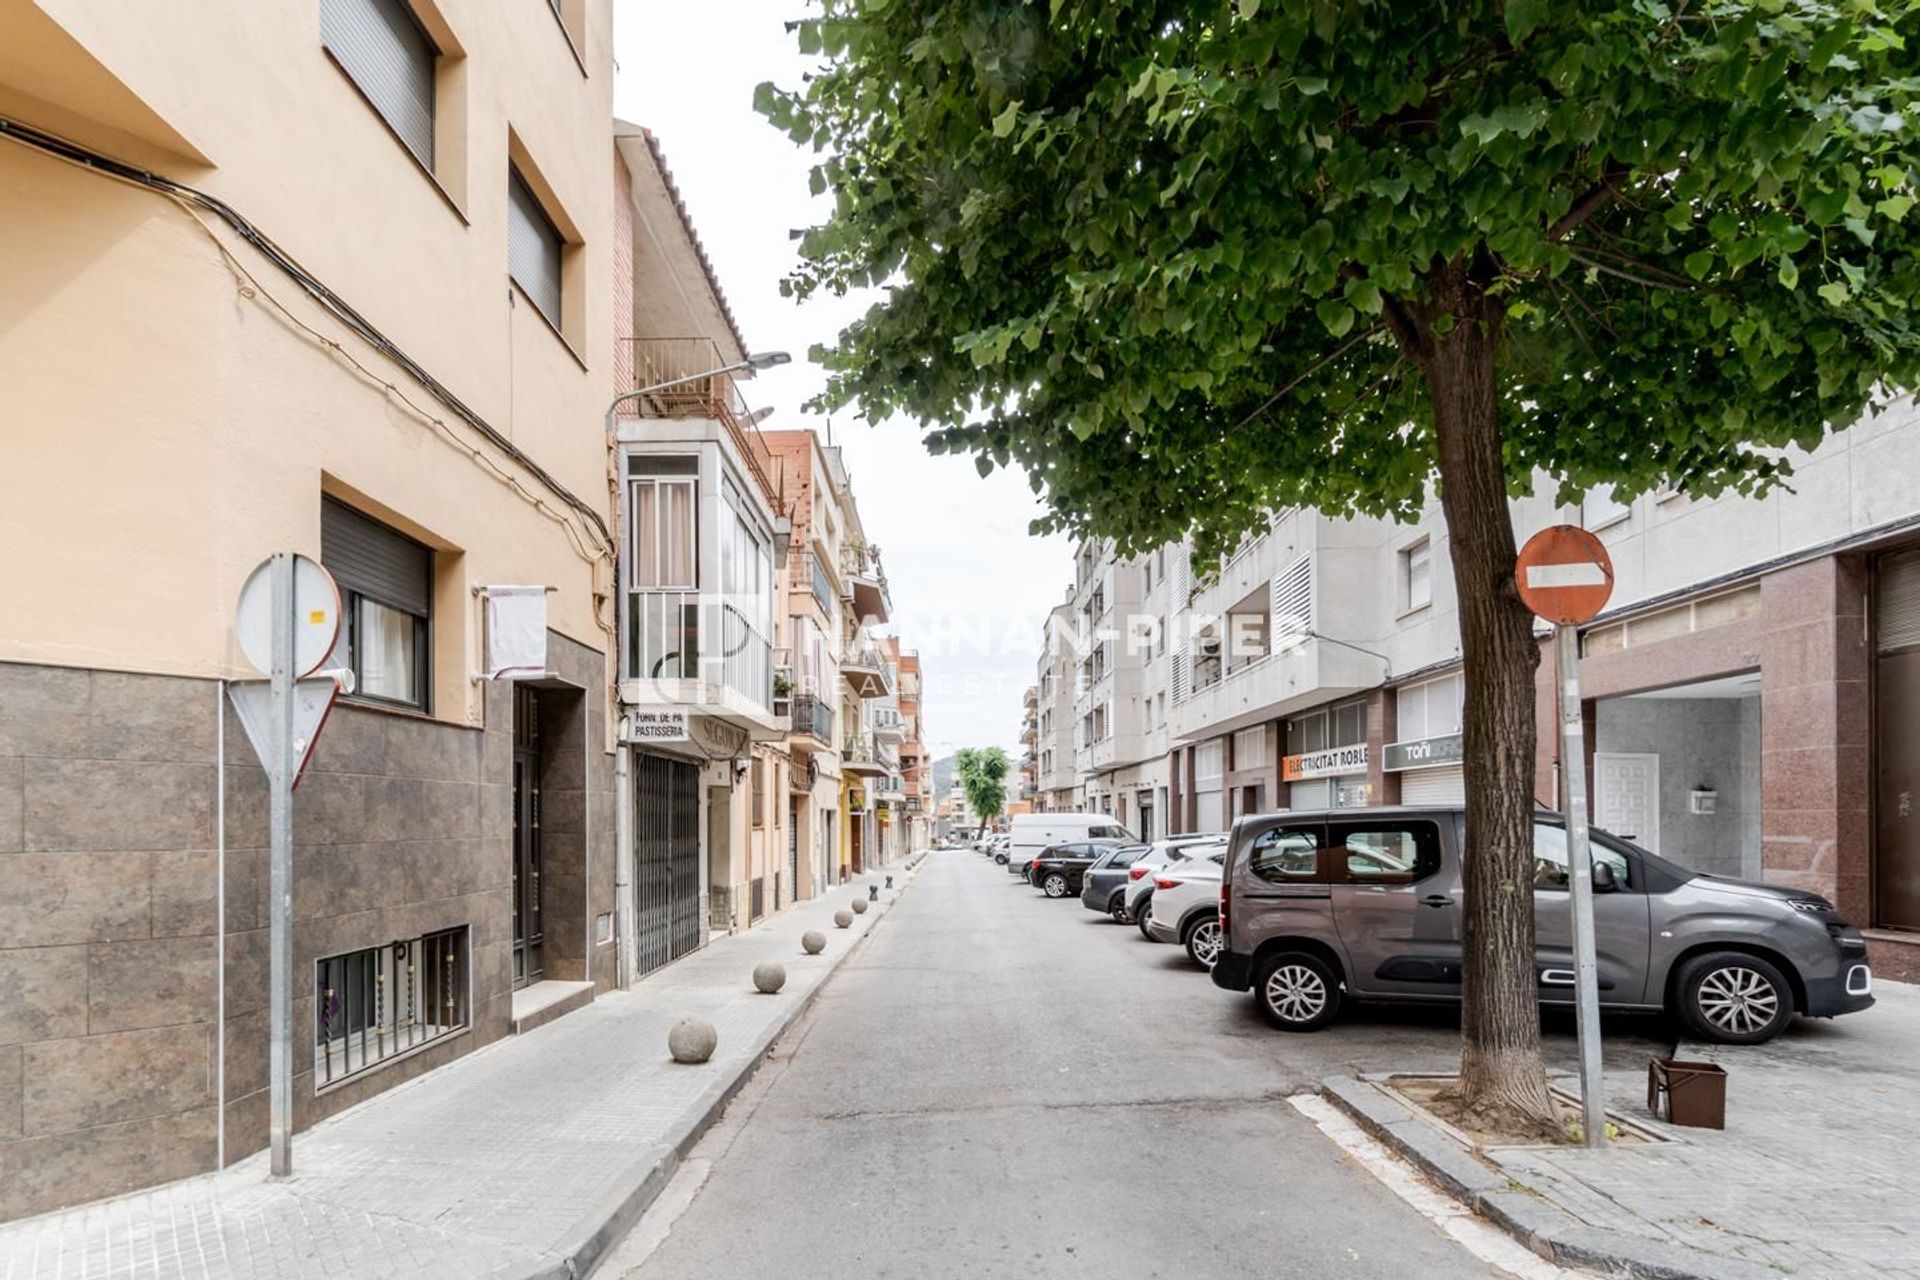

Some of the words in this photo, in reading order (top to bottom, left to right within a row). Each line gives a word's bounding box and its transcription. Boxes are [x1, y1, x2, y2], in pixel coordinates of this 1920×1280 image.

[635, 712, 656, 722] FORN
[660, 712, 669, 722] DE
[672, 712, 683, 722] PA
[635, 726, 683, 737] PASTISSERIA
[1289, 753, 1338, 773] ELECTRICITAT
